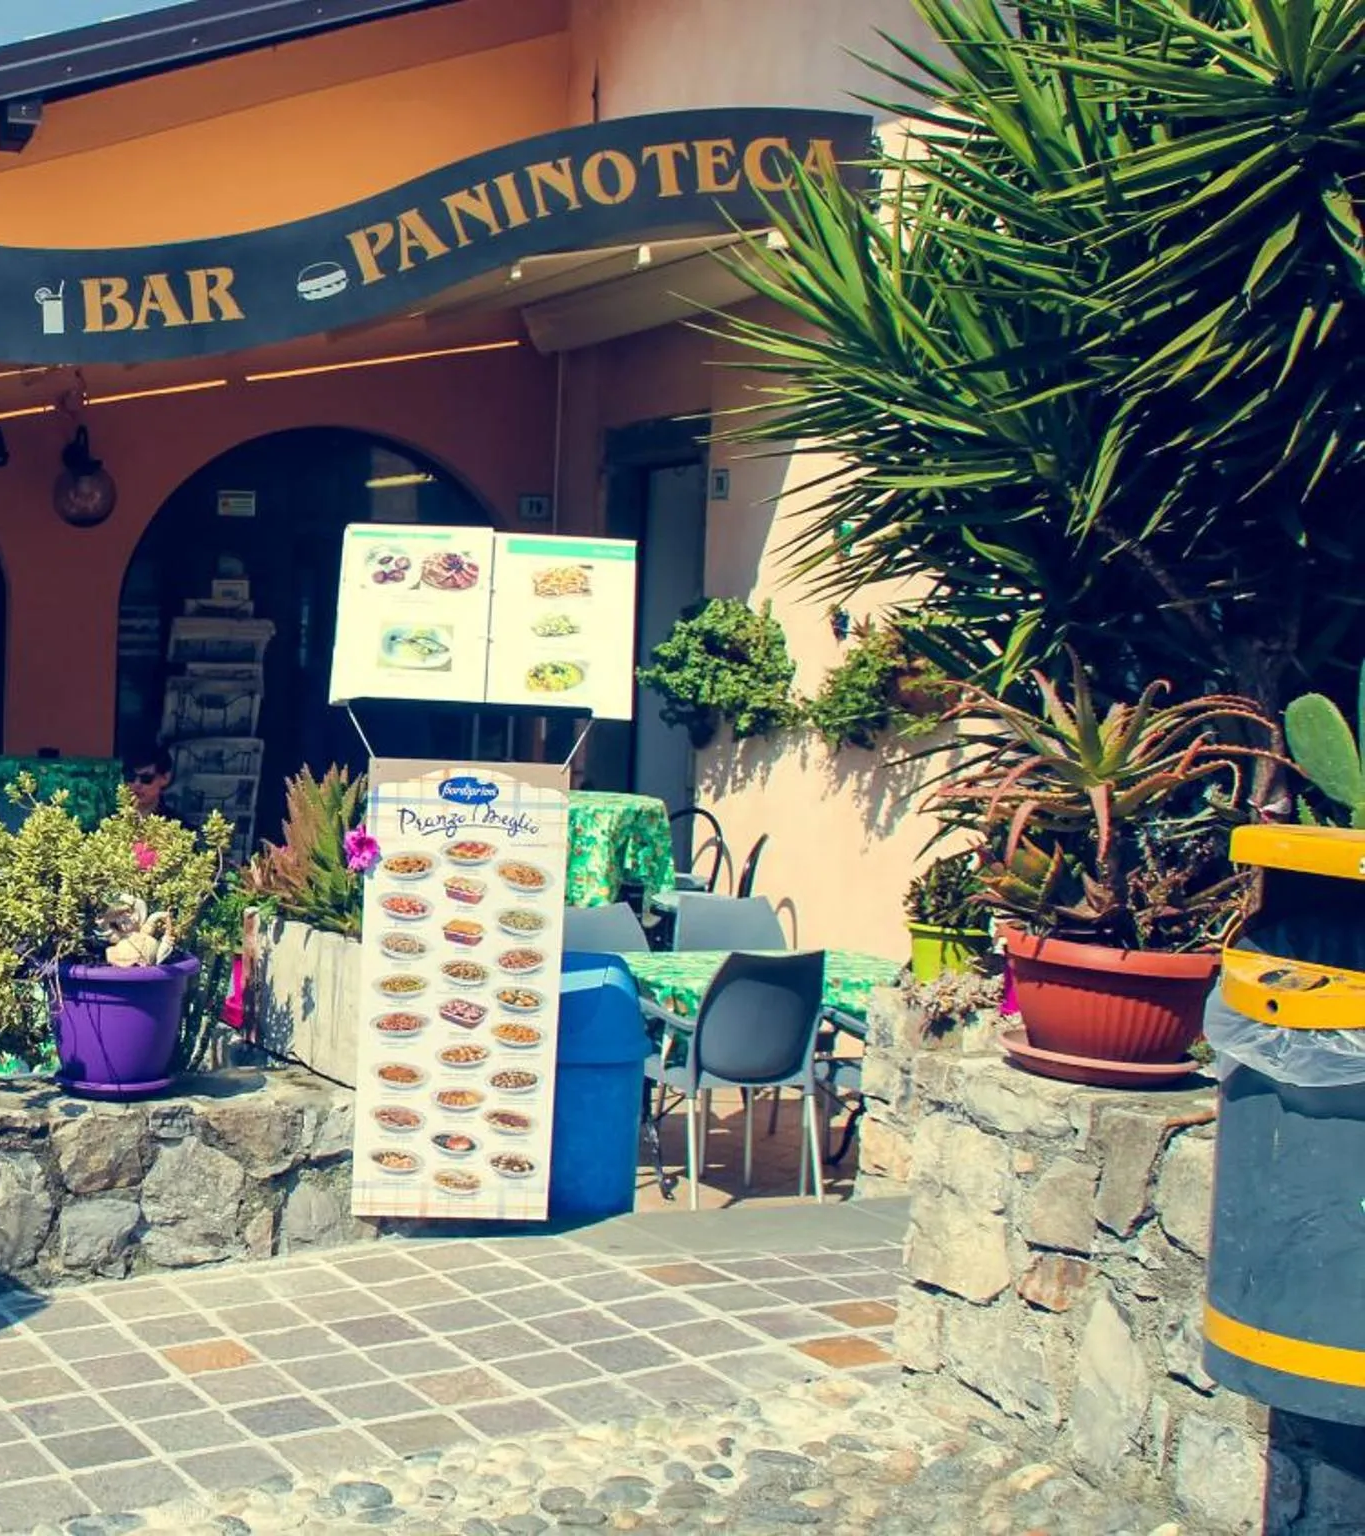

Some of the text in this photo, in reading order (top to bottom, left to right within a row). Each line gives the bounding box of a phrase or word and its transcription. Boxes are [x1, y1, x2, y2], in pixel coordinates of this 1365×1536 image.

[80, 266, 245, 333] BAR
[345, 137, 841, 286] PANINOTECA
[397, 808, 466, 837] Pranzo
